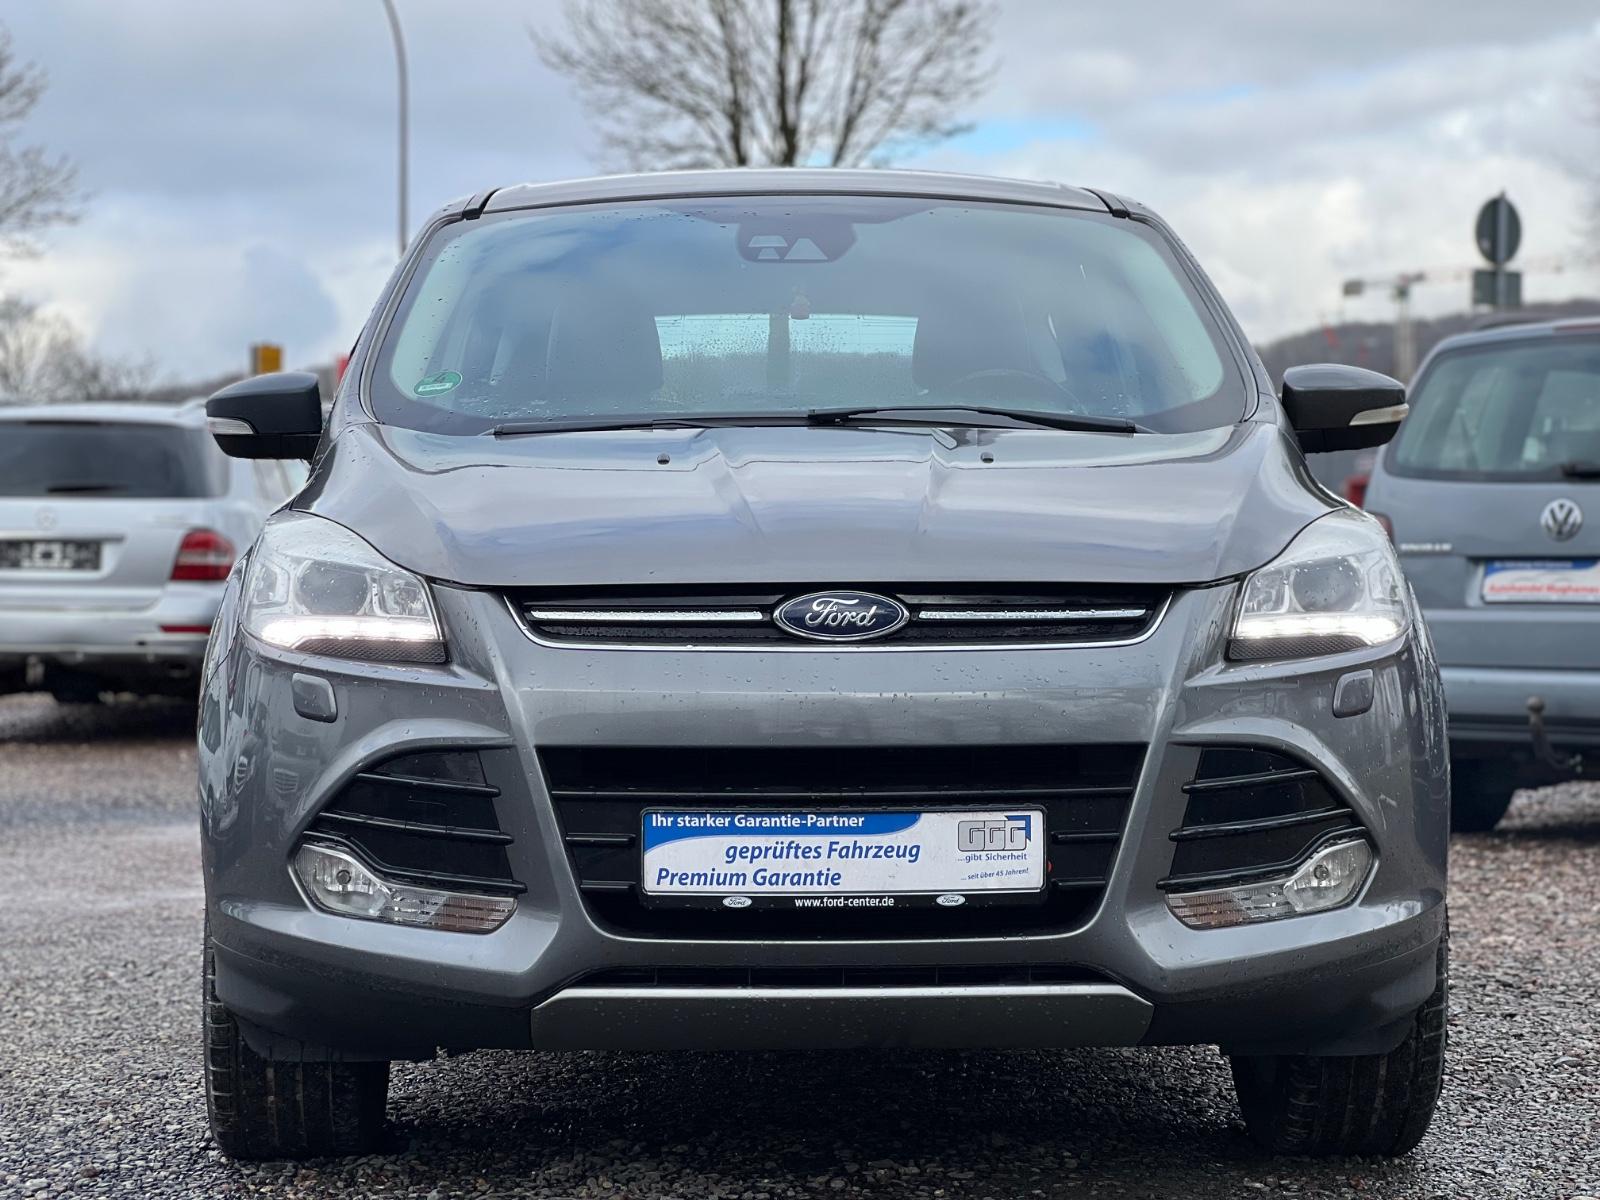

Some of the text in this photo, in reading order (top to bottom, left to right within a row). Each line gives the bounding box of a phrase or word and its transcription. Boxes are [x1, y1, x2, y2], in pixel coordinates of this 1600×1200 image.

[804, 598, 877, 627] Ford
[652, 813, 865, 827] Ihr starker Garantie-Partner
[725, 840, 921, 864] geprüftes Fahrzeug
[985, 852, 1028, 861] Sicherheit
[656, 868, 842, 886] Premium Garantie
[968, 872, 979, 880] seit
[1005, 867, 1029, 876] Jahren!
[795, 896, 895, 907] www.ford-center.de
